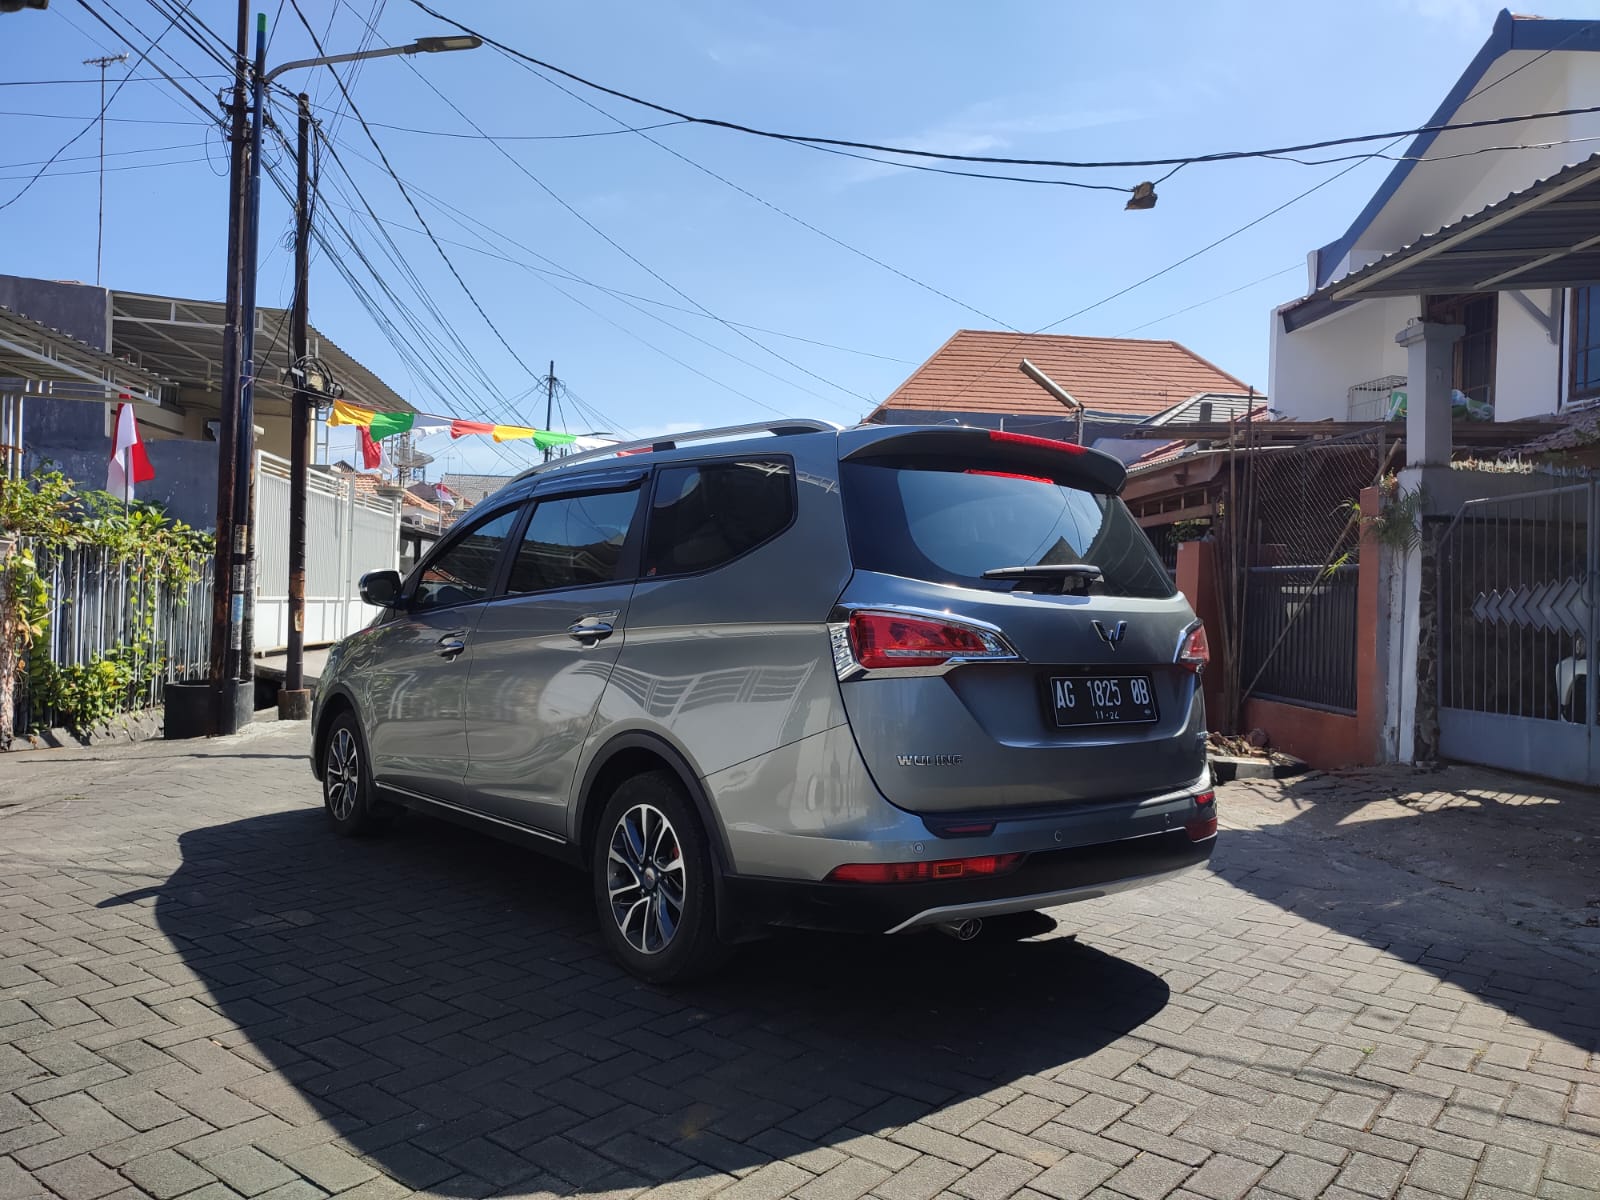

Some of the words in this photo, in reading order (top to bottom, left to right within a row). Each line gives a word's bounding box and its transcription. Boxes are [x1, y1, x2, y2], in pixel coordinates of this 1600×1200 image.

[1056, 680, 1075, 709] AG
[1087, 680, 1121, 707] 1825
[896, 754, 963, 767] WULING
